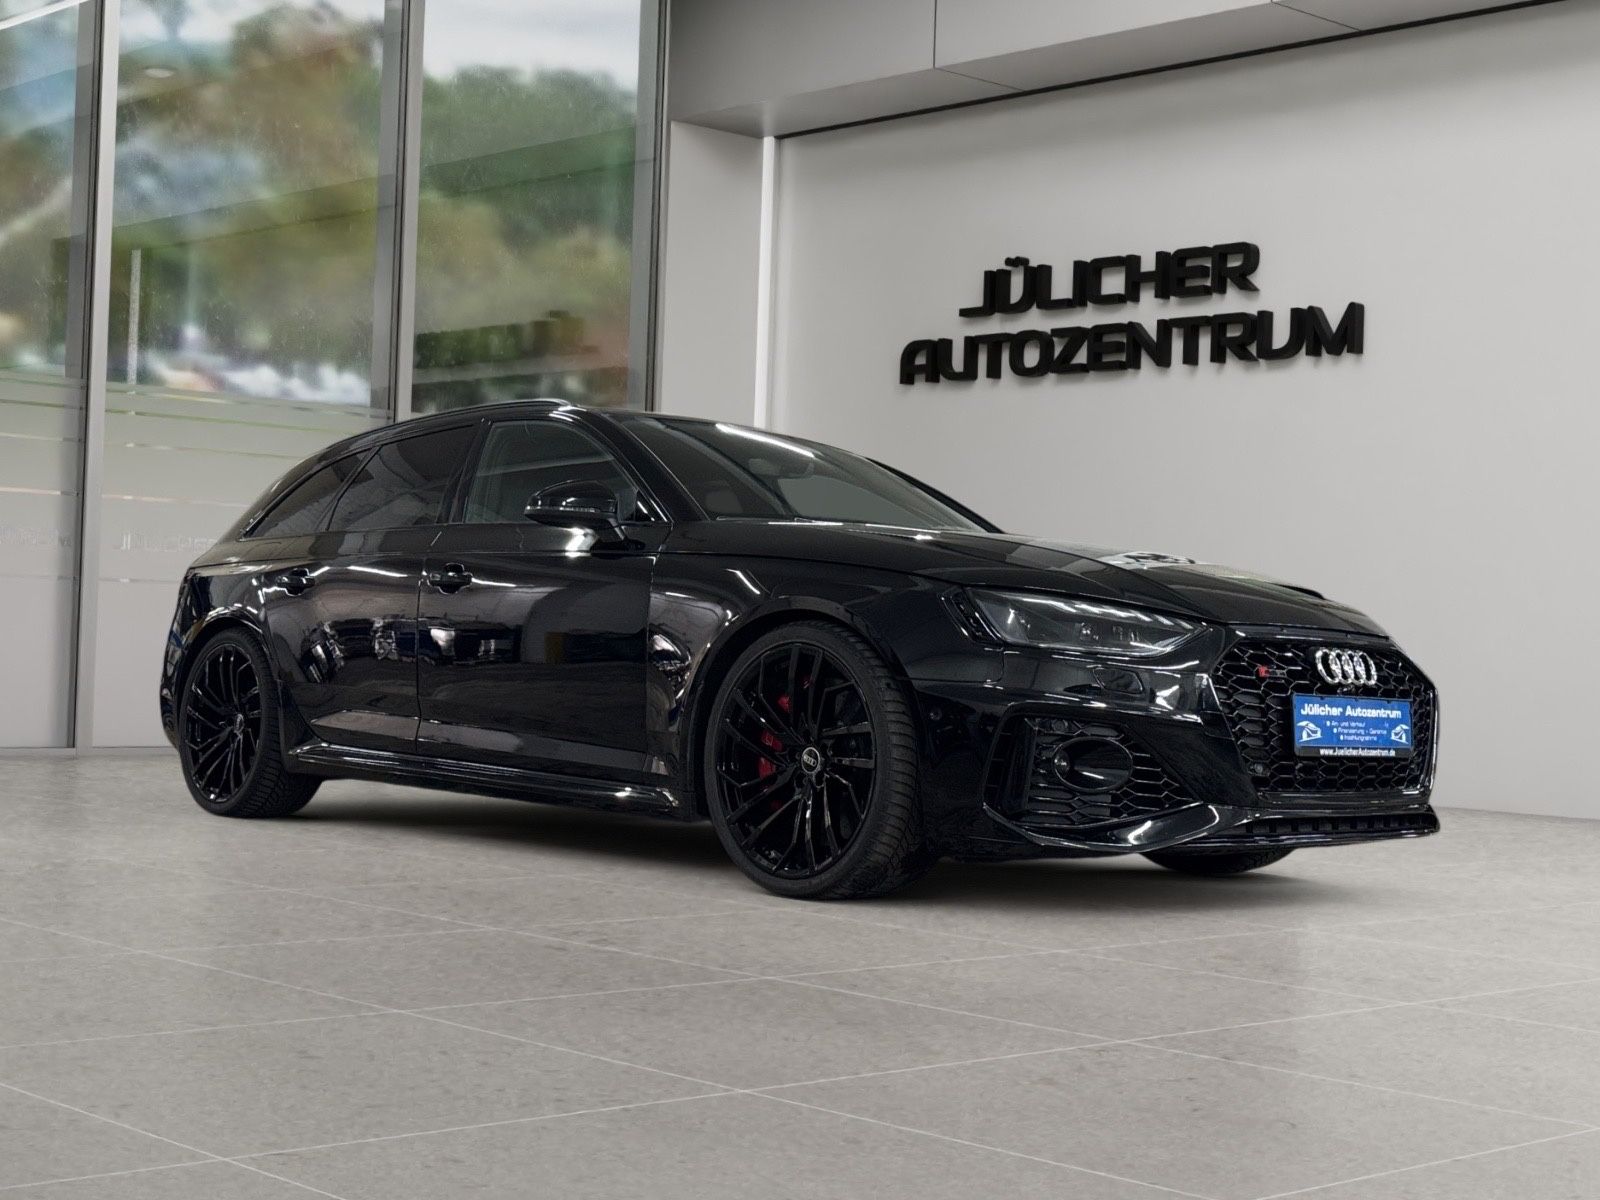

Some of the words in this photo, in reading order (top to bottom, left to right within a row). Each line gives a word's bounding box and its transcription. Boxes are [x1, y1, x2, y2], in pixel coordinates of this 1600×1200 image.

[959, 241, 1260, 318] JÜLICHER
[900, 301, 1365, 385] AUTOZENTRUM
[1300, 703, 1343, 716] Jülicher
[1345, 705, 1402, 719] Autozentrum
[1319, 747, 1396, 757] www.JuelicherAutozentrum.de
